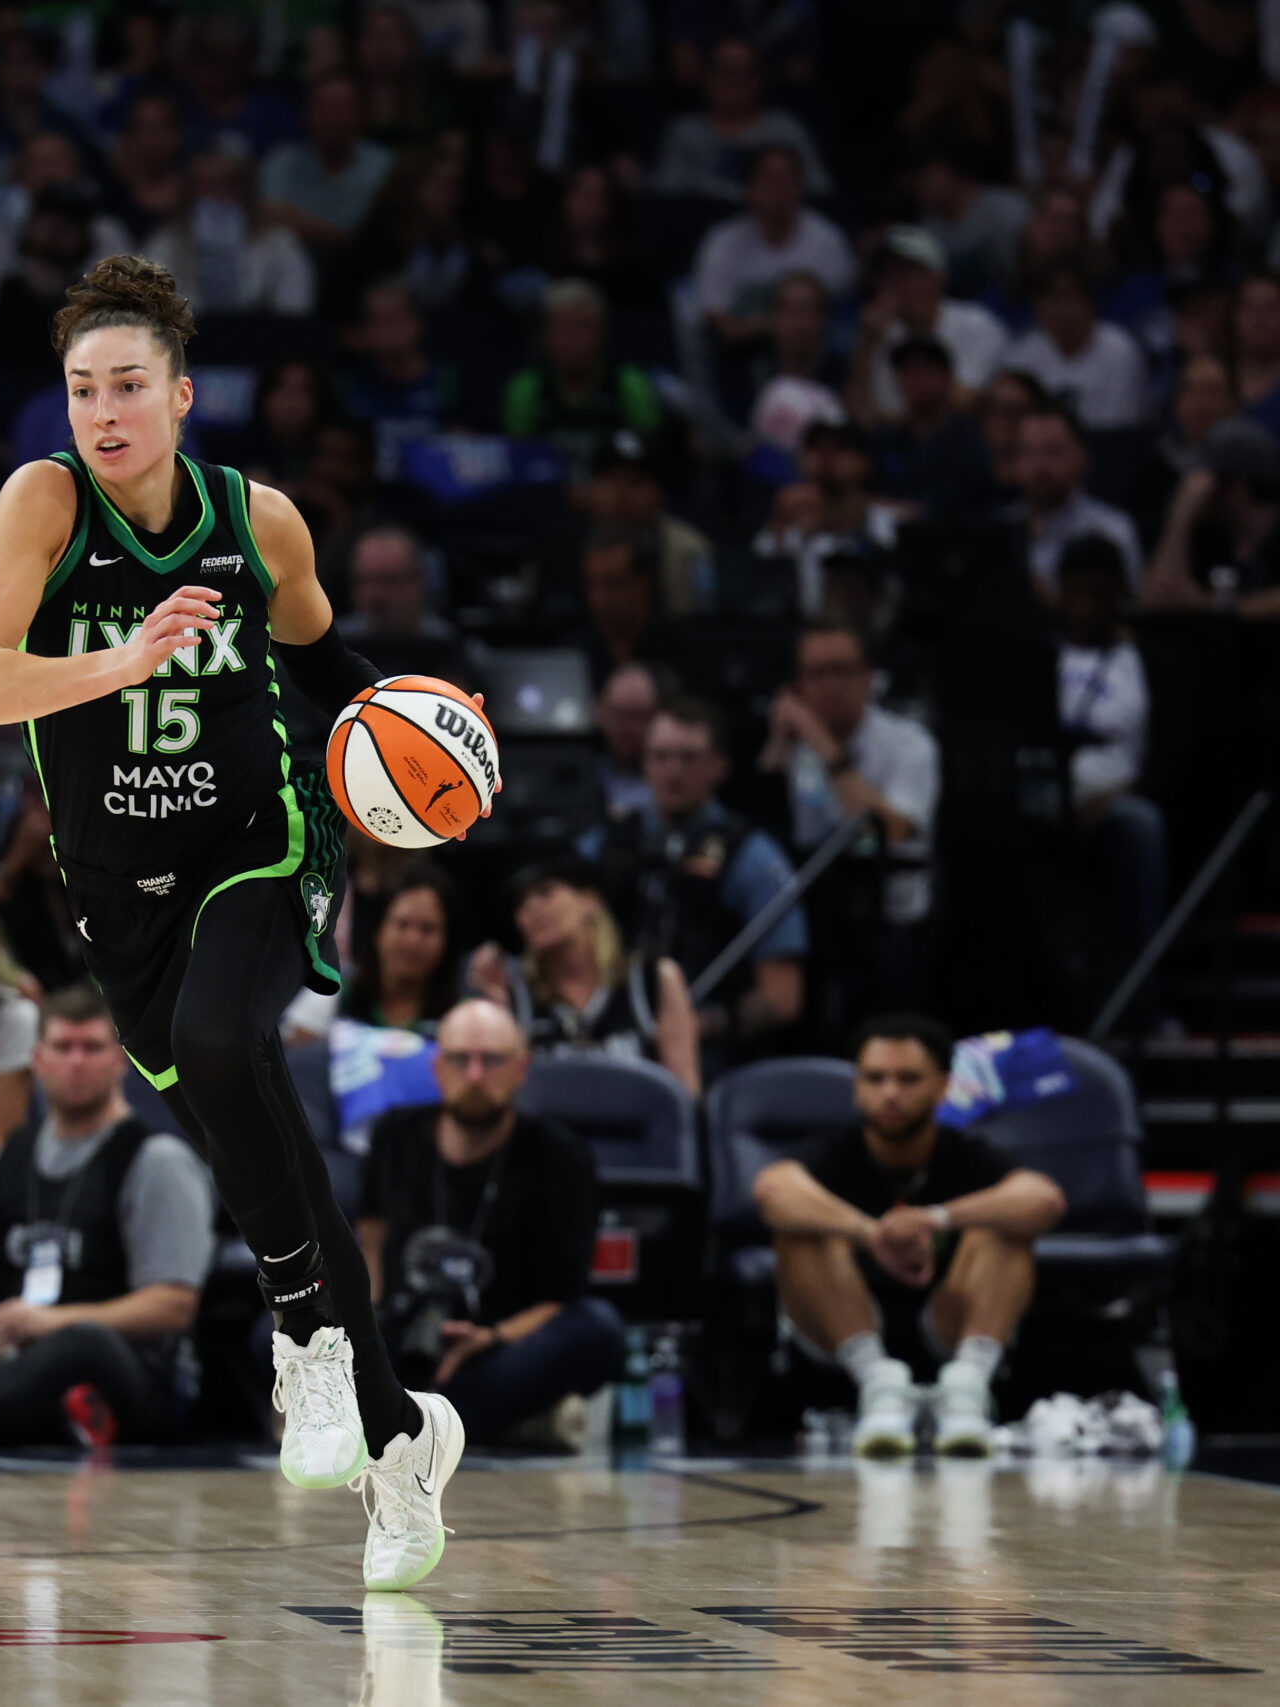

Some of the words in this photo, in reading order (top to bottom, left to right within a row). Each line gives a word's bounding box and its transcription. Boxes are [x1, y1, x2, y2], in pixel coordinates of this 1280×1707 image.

[73, 601, 244, 620] MINNTA
[121, 688, 201, 755] 15
[435, 702, 496, 798] Wilson
[113, 761, 215, 789] MAYO
[103, 782, 218, 819] CLINIC
[136, 872, 176, 888] CHANGE
